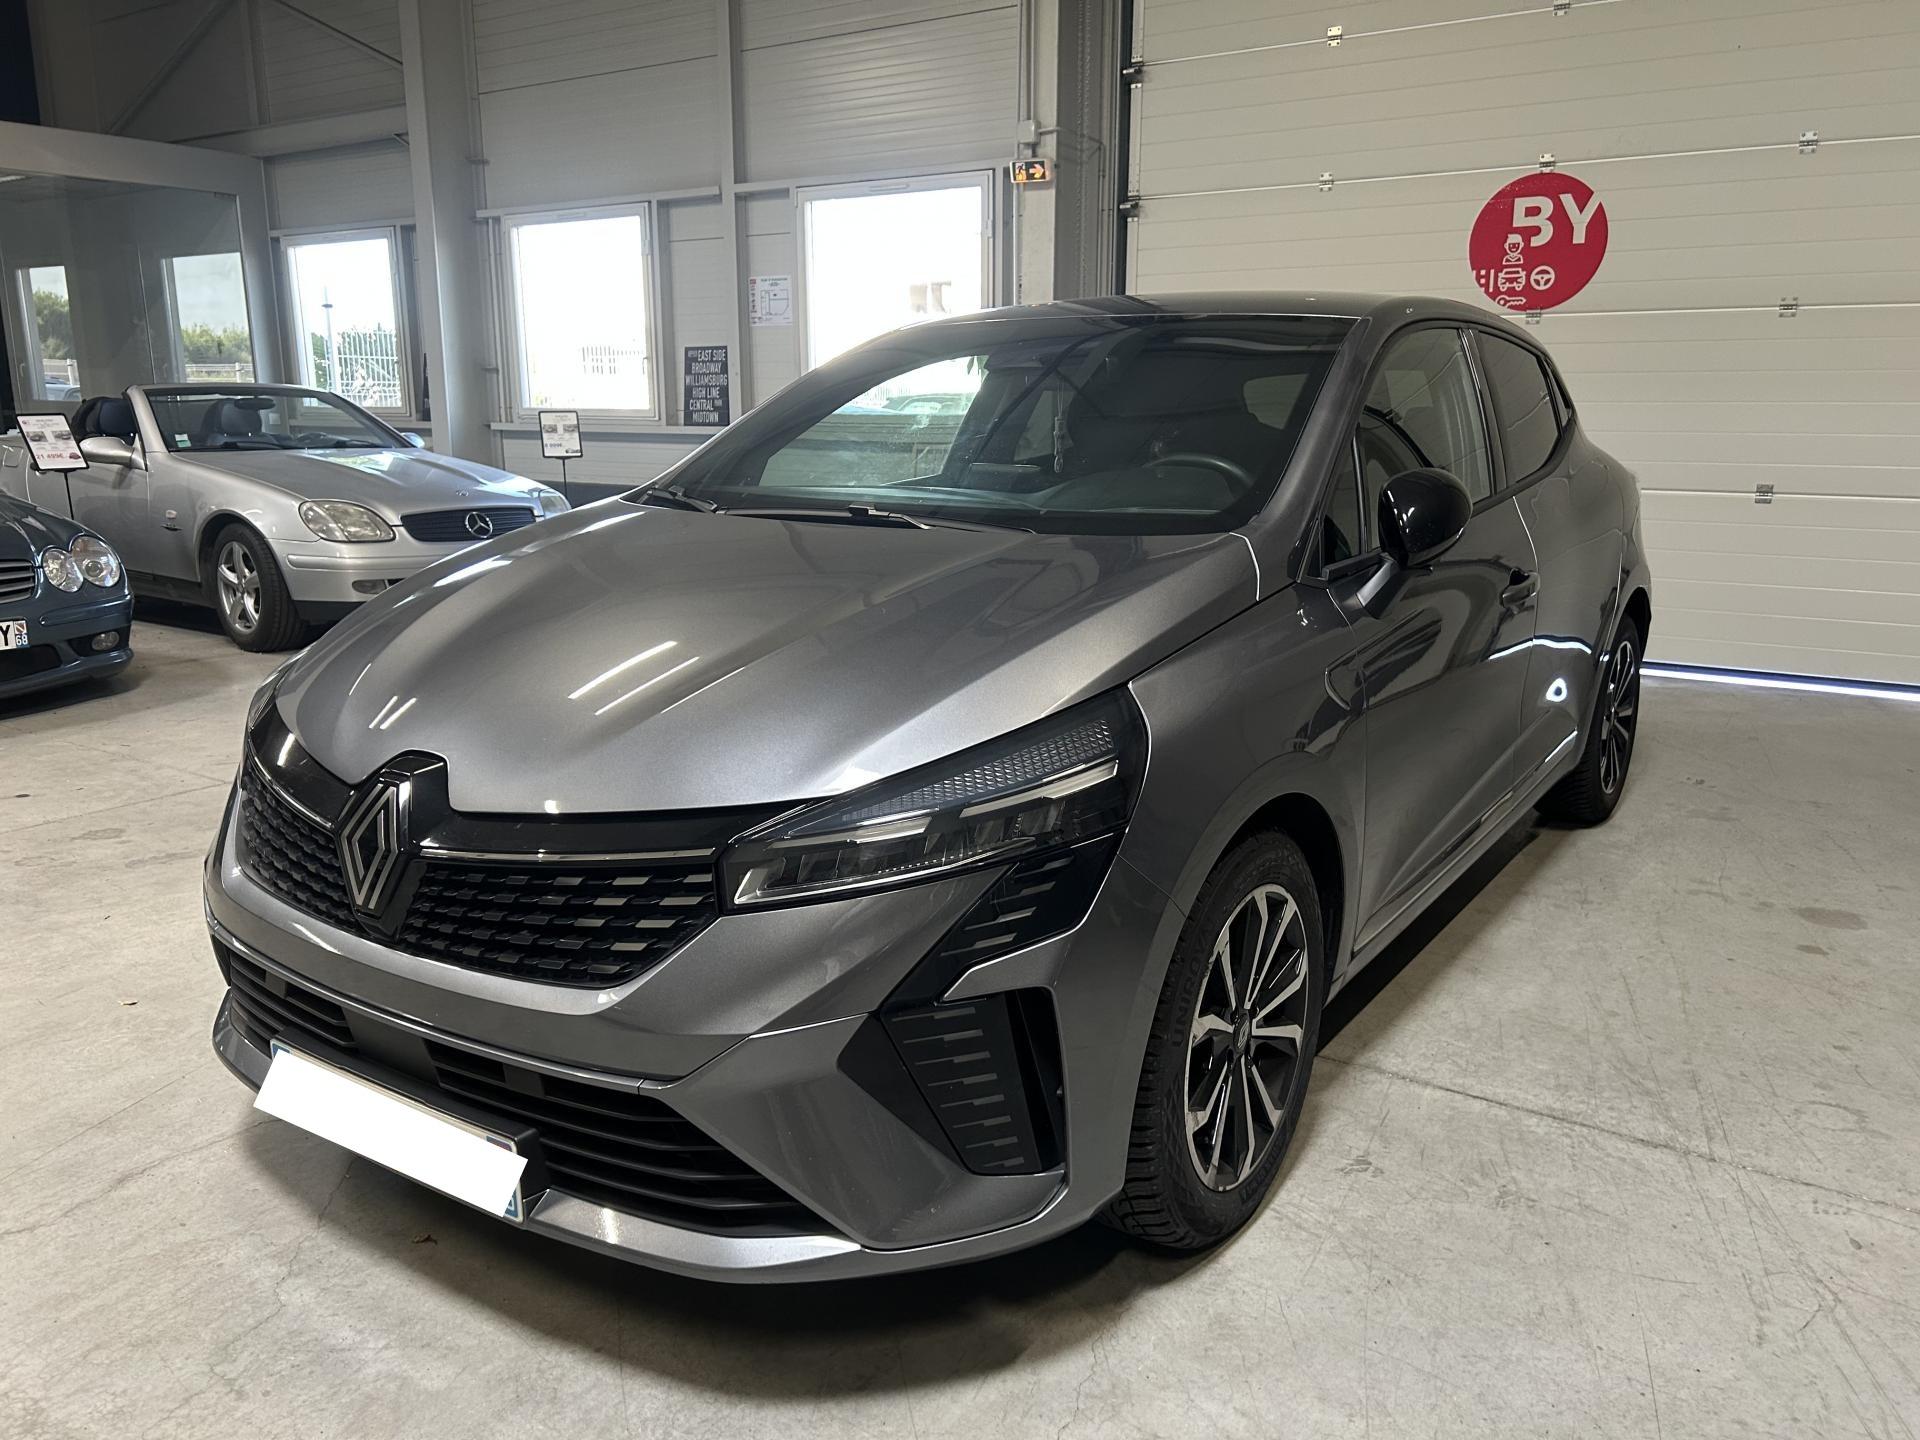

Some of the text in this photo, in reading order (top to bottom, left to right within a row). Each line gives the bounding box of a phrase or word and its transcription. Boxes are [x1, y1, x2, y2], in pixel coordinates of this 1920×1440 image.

[1512, 191, 1601, 248] BY
[698, 350, 712, 361] EAST
[712, 349, 726, 361] SIDE
[691, 362, 722, 374] BROADWAY
[685, 374, 728, 386] WILLIAMSBURG
[692, 387, 720, 398] HIGH LINE
[689, 399, 714, 411] CENTRAL
[692, 411, 719, 423] MIDTOWN
[16, 634, 28, 645] 68
